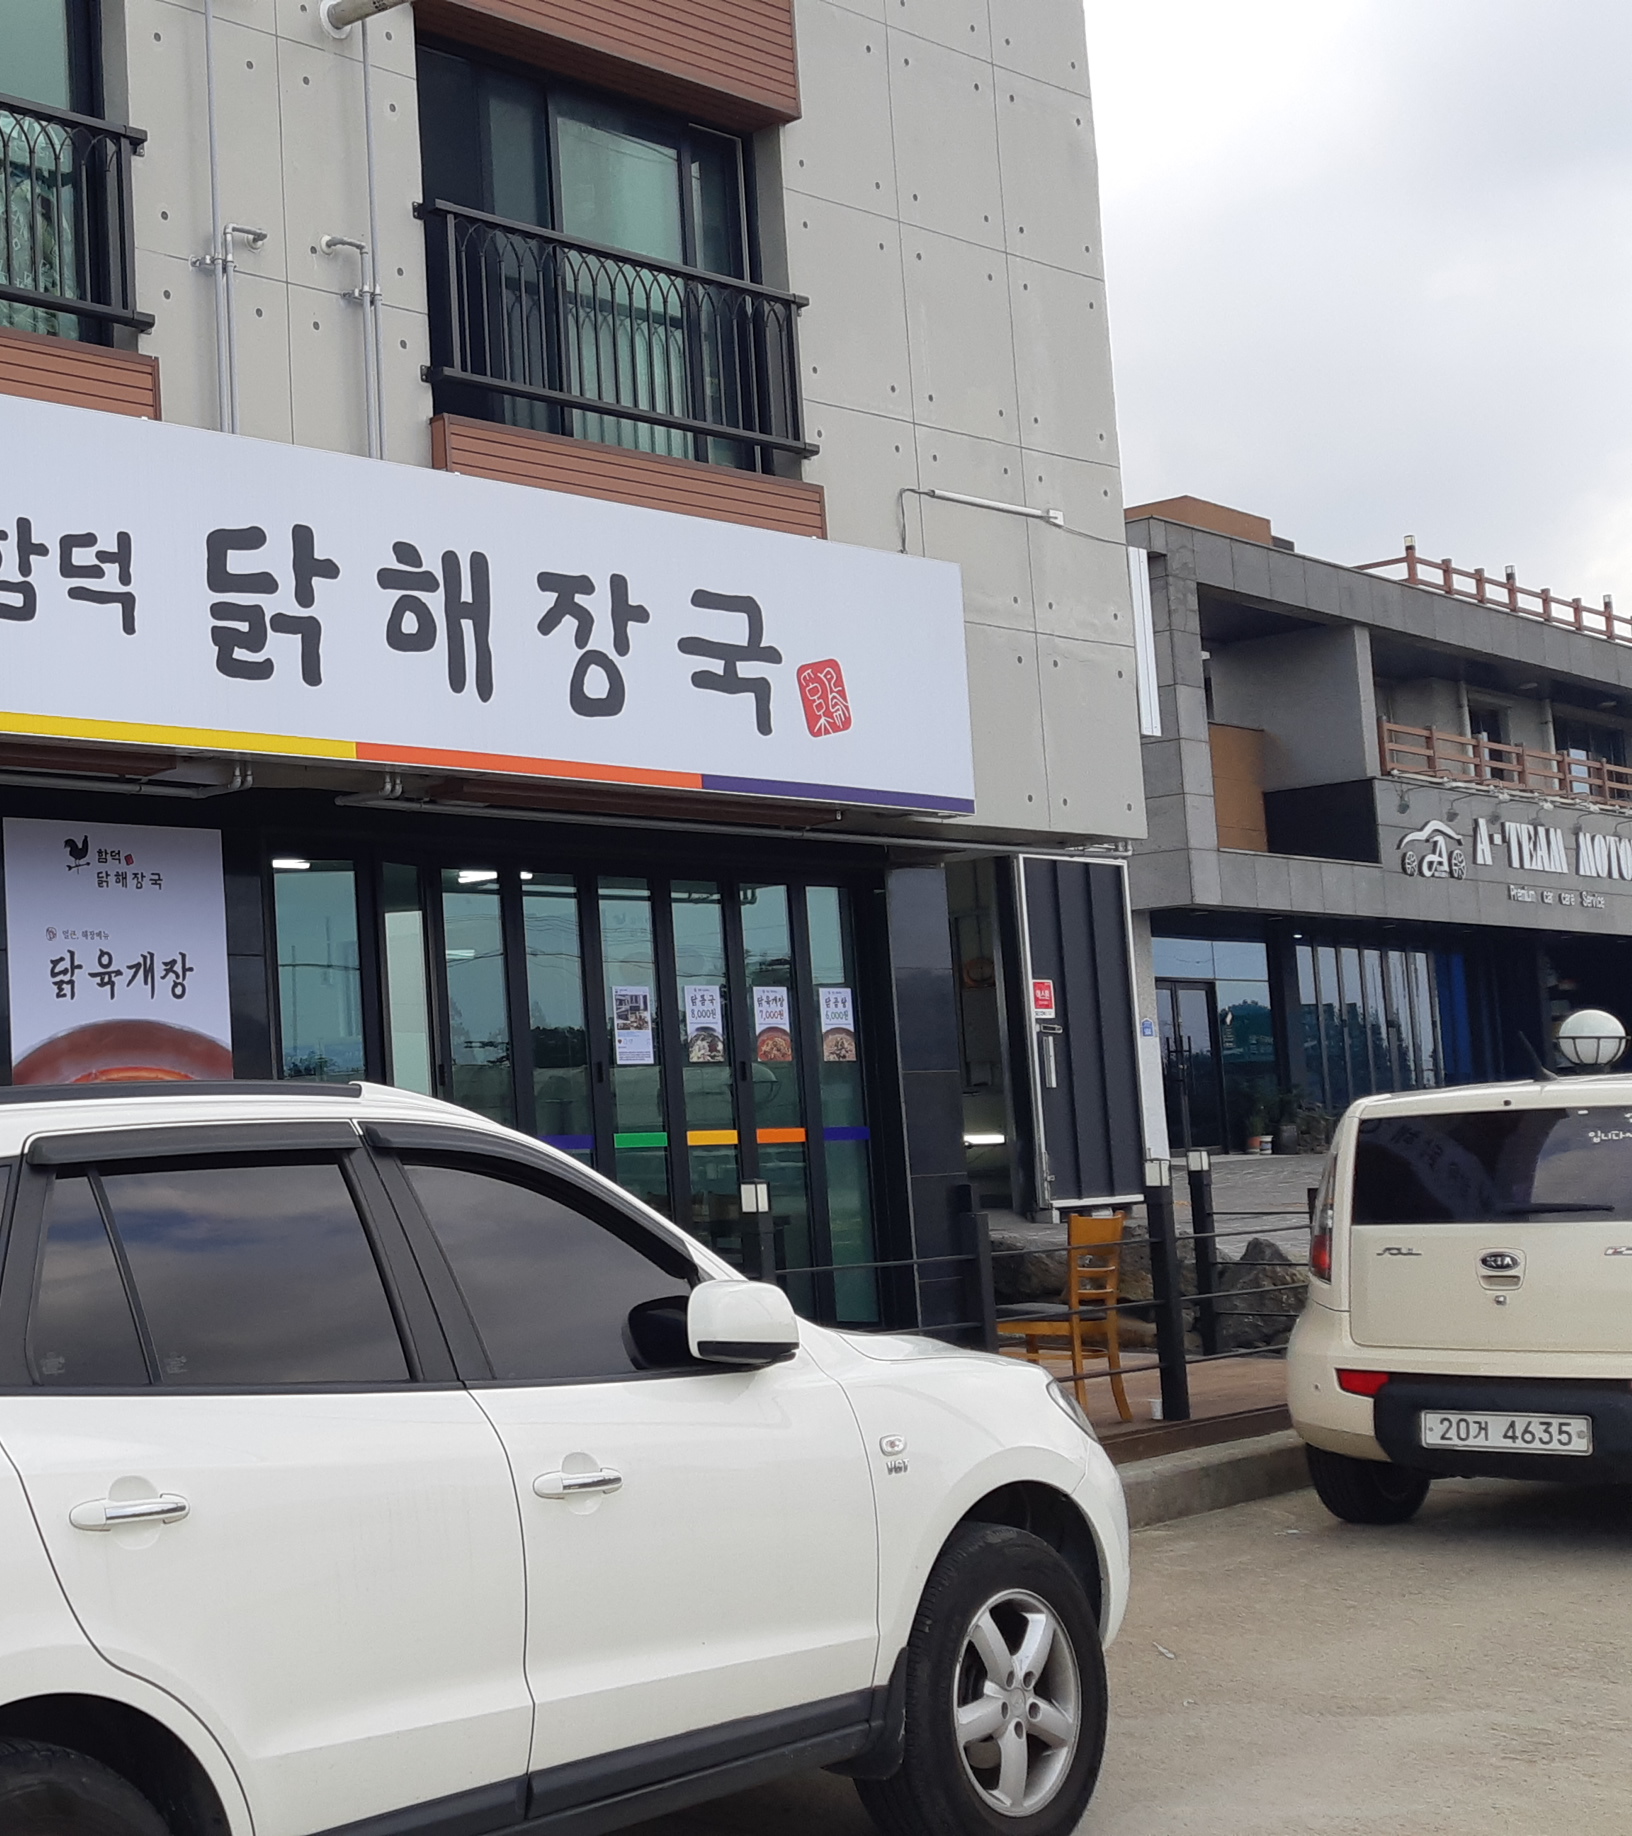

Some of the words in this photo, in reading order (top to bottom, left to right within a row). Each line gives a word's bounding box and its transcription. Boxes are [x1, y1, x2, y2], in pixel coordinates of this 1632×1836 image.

[205, 522, 783, 737] 닭해장국
[96, 848, 122, 864] 함덕
[1475, 817, 1568, 874] A-TEAM
[1576, 831, 1632, 881] MOTO
[96, 871, 164, 890] 닭해장국
[1509, 884, 1536, 902] Premium
[1542, 890, 1554, 905] car
[1560, 891, 1576, 906] care
[1581, 891, 1606, 909] Service
[49, 949, 194, 1001] 닭육개장
[757, 995, 785, 1008] 닭육개장
[691, 1008, 716, 1020] 8,000원
[759, 1009, 784, 1021] 7,000원
[825, 1010, 848, 1022] 6,000원
[1486, 1256, 1513, 1268] KIA
[1439, 1417, 1489, 1442] 20거
[1503, 1419, 1573, 1446] 4635
[886, 1458, 910, 1475] VGT
